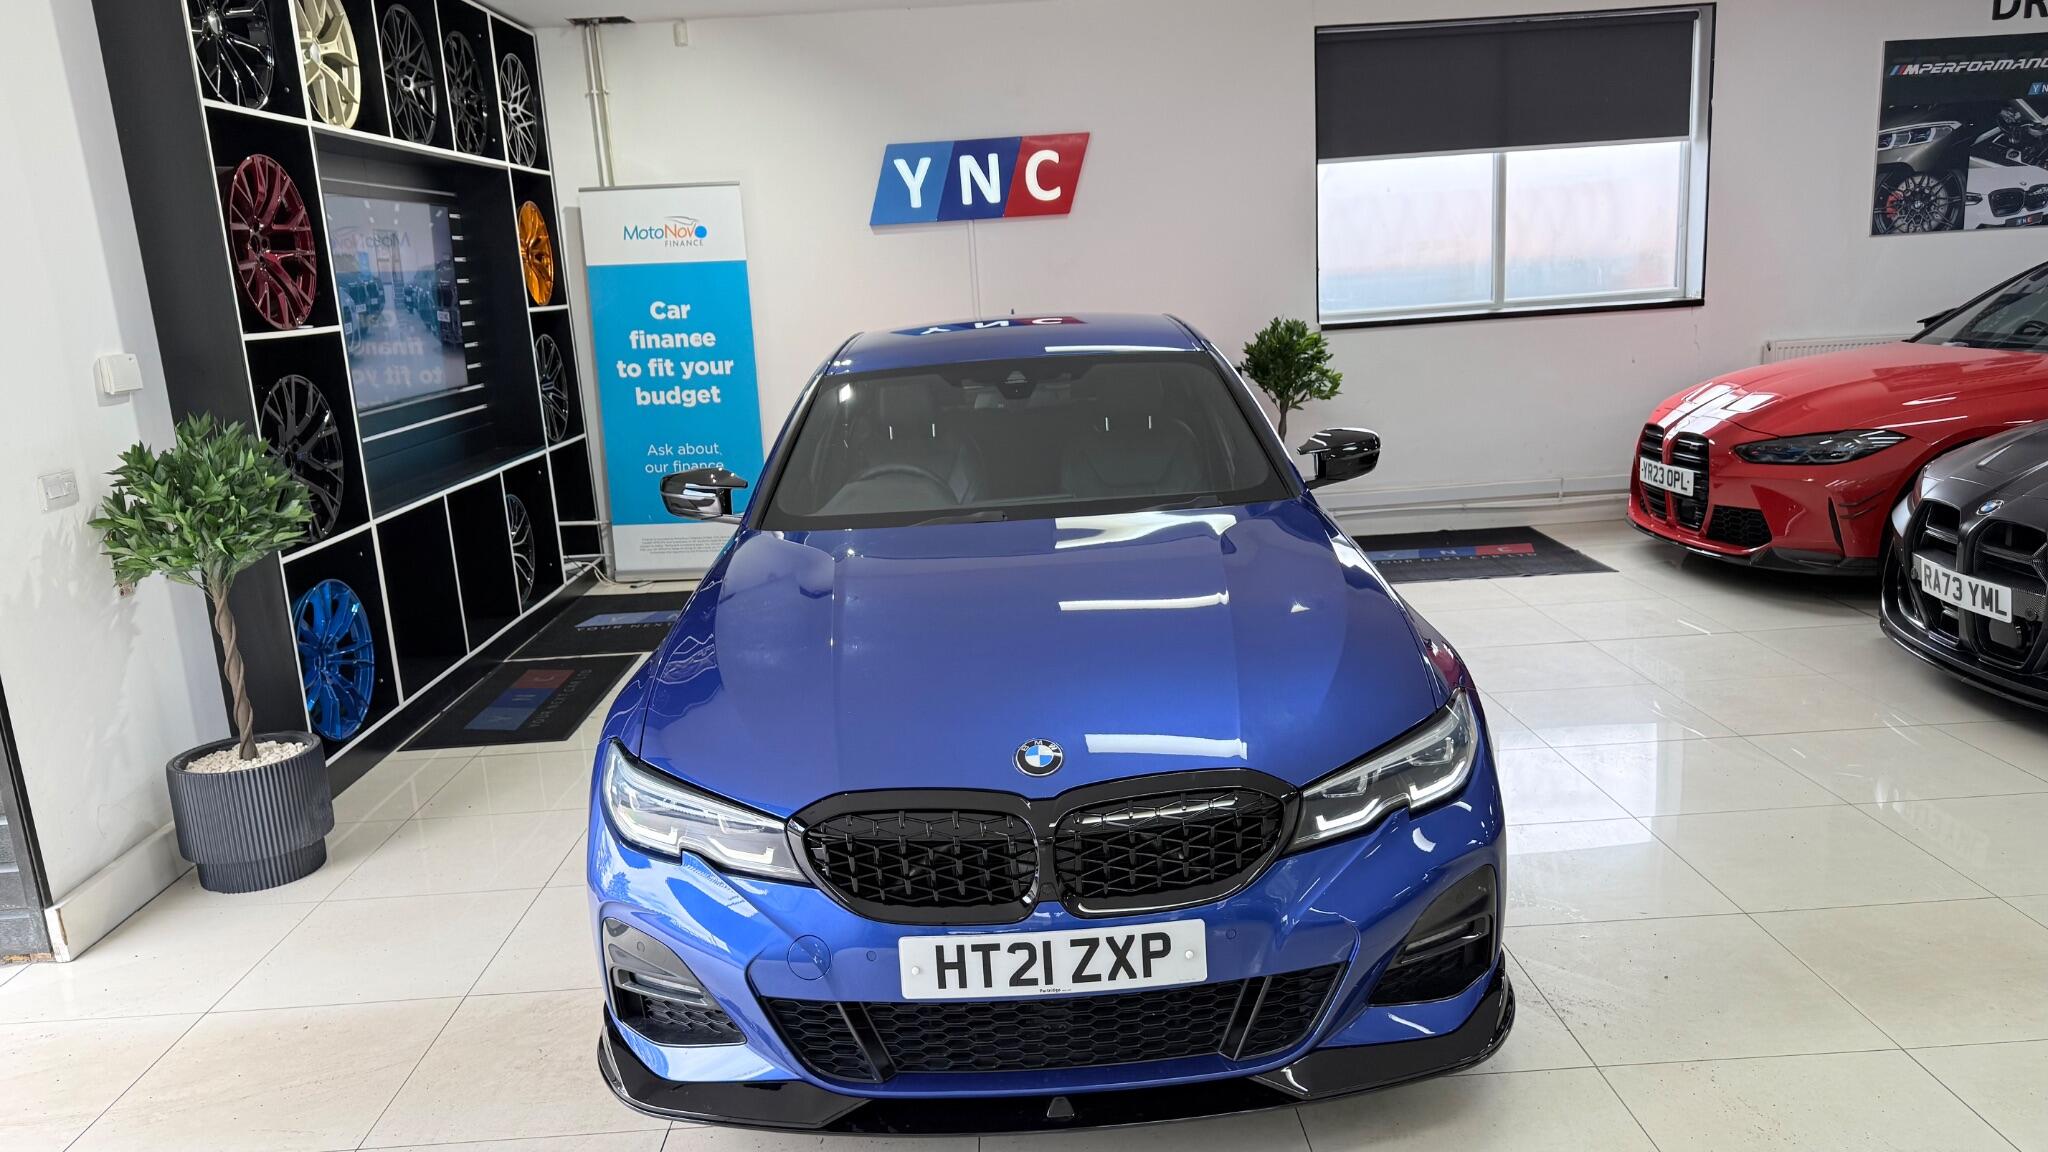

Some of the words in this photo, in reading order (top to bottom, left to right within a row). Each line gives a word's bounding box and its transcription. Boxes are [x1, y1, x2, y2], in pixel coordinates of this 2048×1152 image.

[893, 149, 1061, 208] YNC
[624, 223, 707, 241] MotoNovo
[664, 240, 704, 248] FINANCE
[649, 300, 691, 320] Car
[629, 330, 717, 350] finance
[616, 360, 642, 378] to
[647, 358, 675, 378] fit
[680, 359, 735, 380] your
[635, 386, 721, 408] budget
[647, 443, 674, 456] Ask
[677, 442, 721, 455] about
[645, 463, 669, 473] our
[1643, 460, 1665, 485] YR23
[1667, 469, 1688, 491] OPL
[1923, 563, 1963, 602] RA73
[1967, 581, 2008, 617] YML
[1020, 740, 1059, 752] BMW
[935, 940, 1054, 989] HT21
[1069, 931, 1172, 984] ZXP
